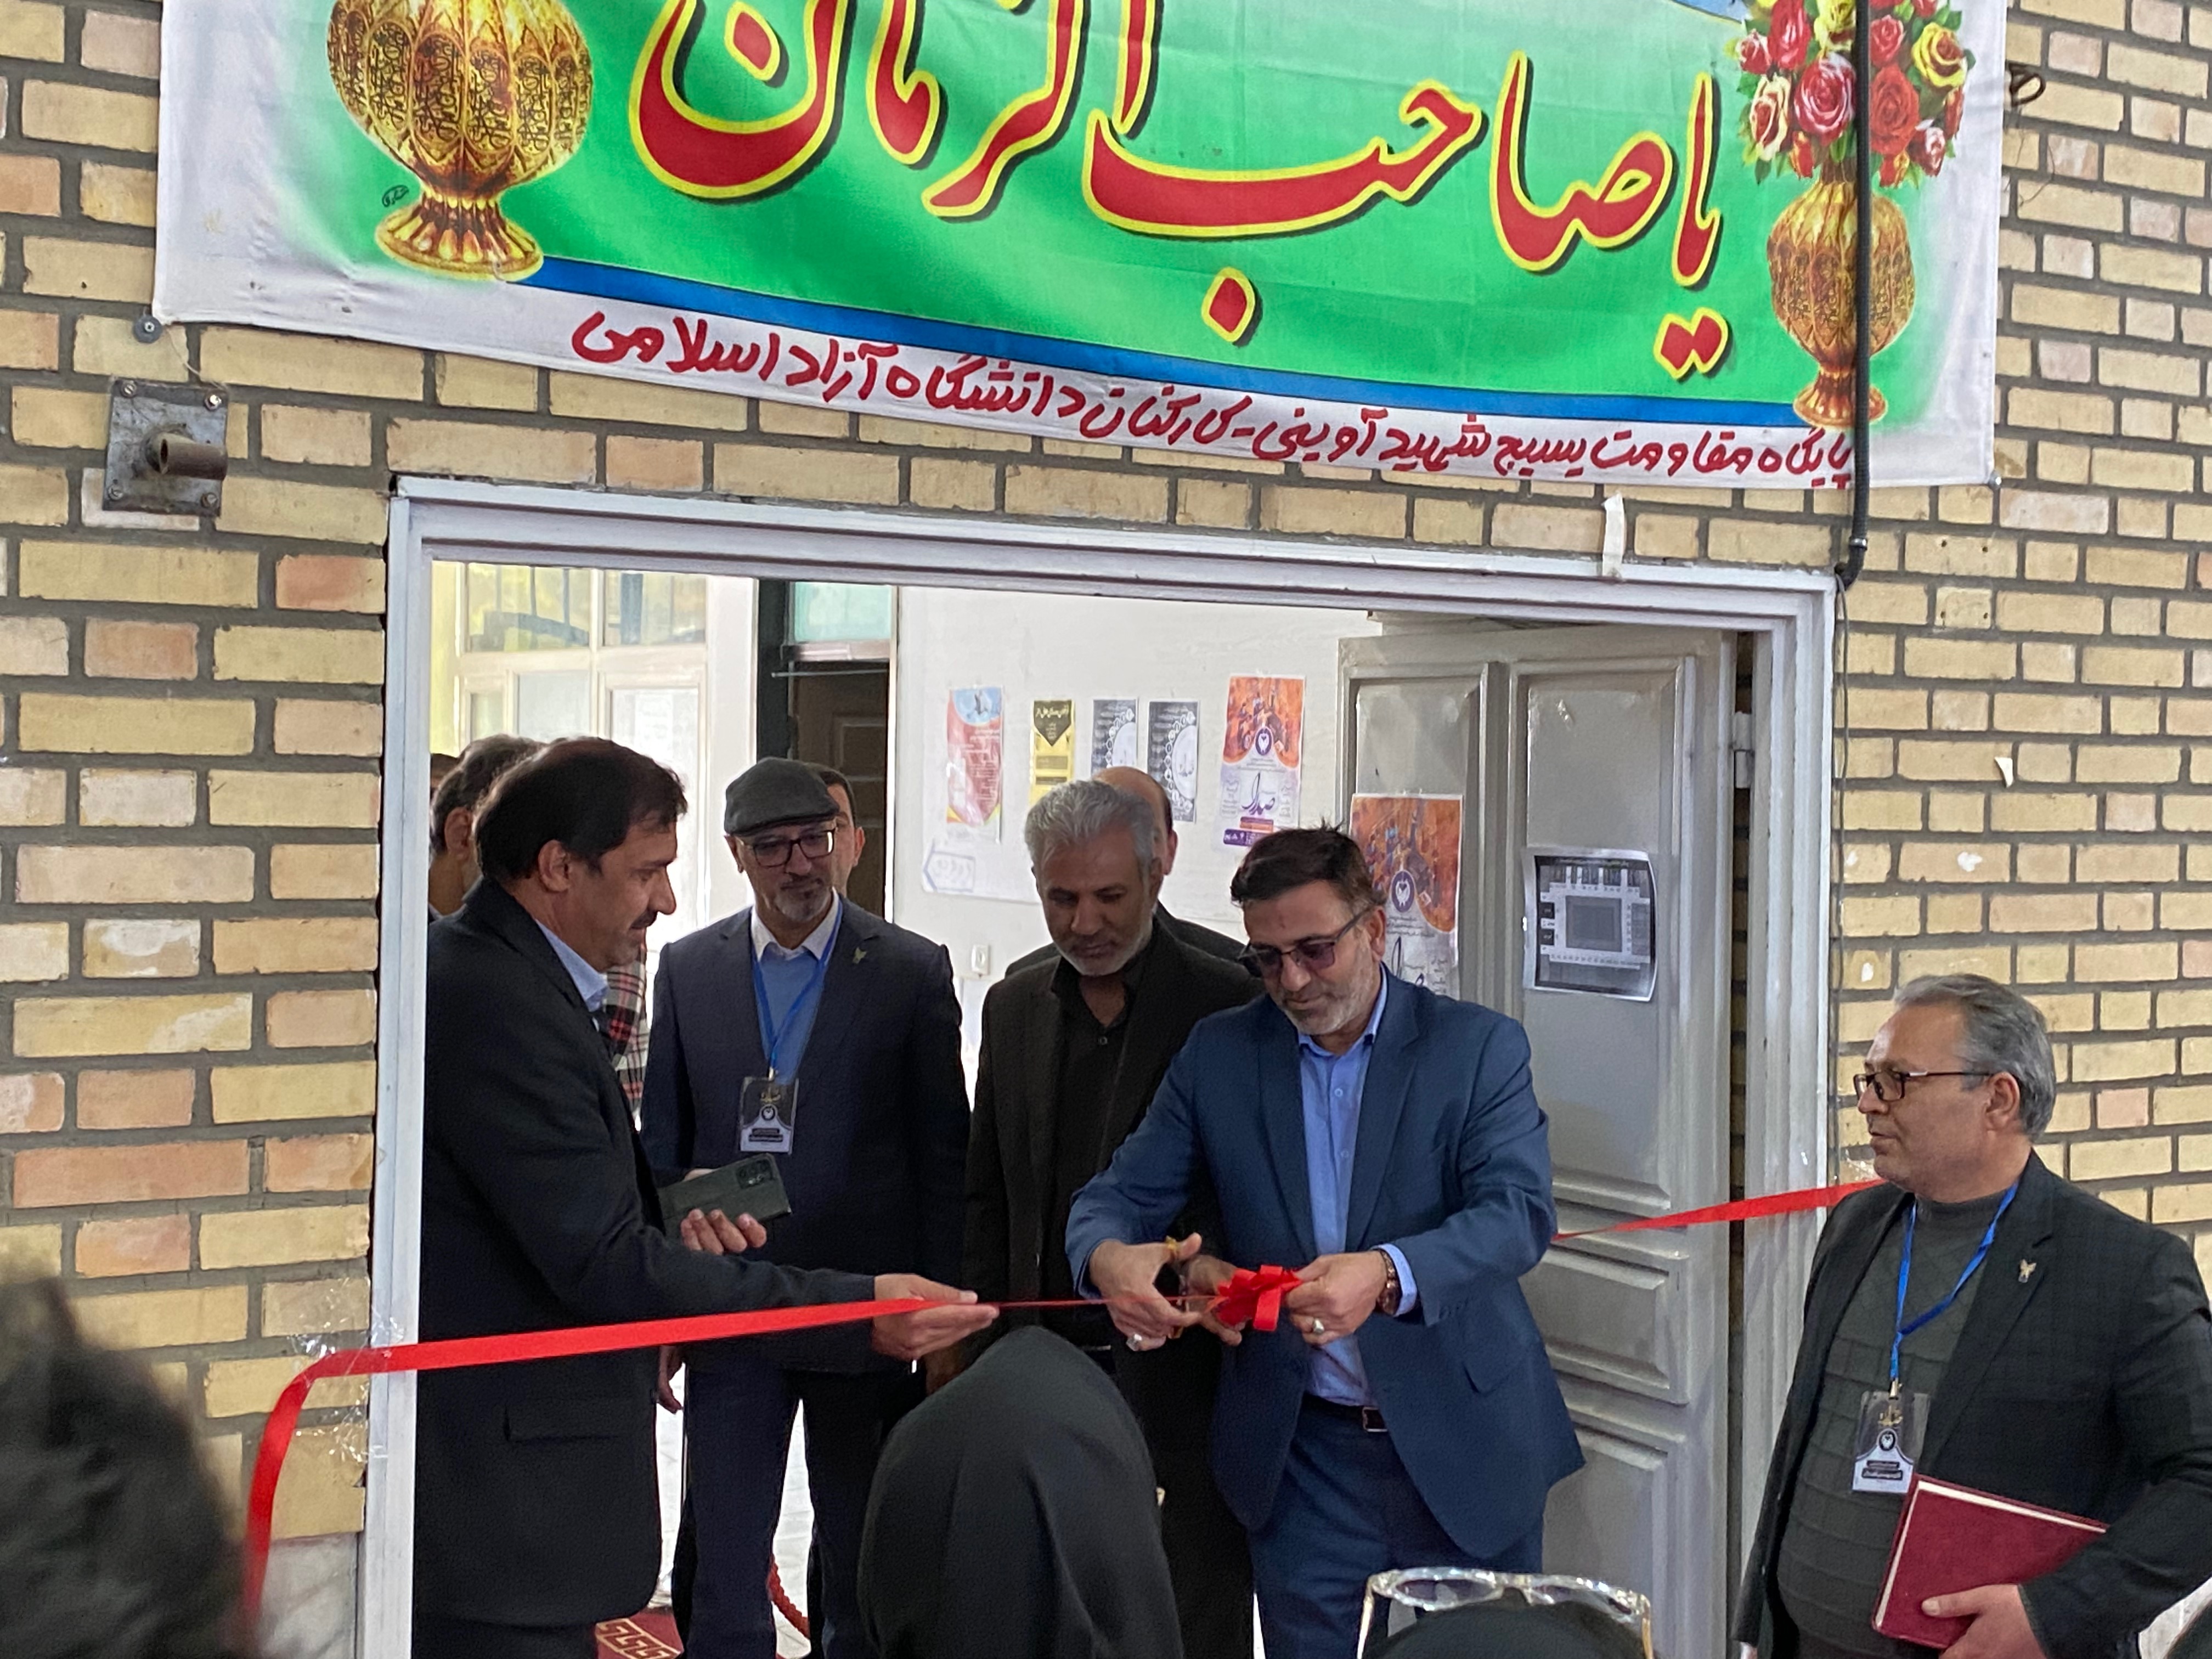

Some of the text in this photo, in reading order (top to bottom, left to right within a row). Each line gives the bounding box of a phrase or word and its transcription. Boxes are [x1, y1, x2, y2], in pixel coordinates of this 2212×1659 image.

[1082, 49, 1674, 343] صاحب
[571, 311, 781, 381] اسلامی
[785, 338, 900, 403] آزاد
[885, 353, 1087, 418] دانشگاه
[1379, 413, 1492, 473] شهید
[1493, 436, 1587, 477] بسیج
[1590, 430, 1753, 476] مقاومت
[1757, 426, 1853, 490] پایگاه
